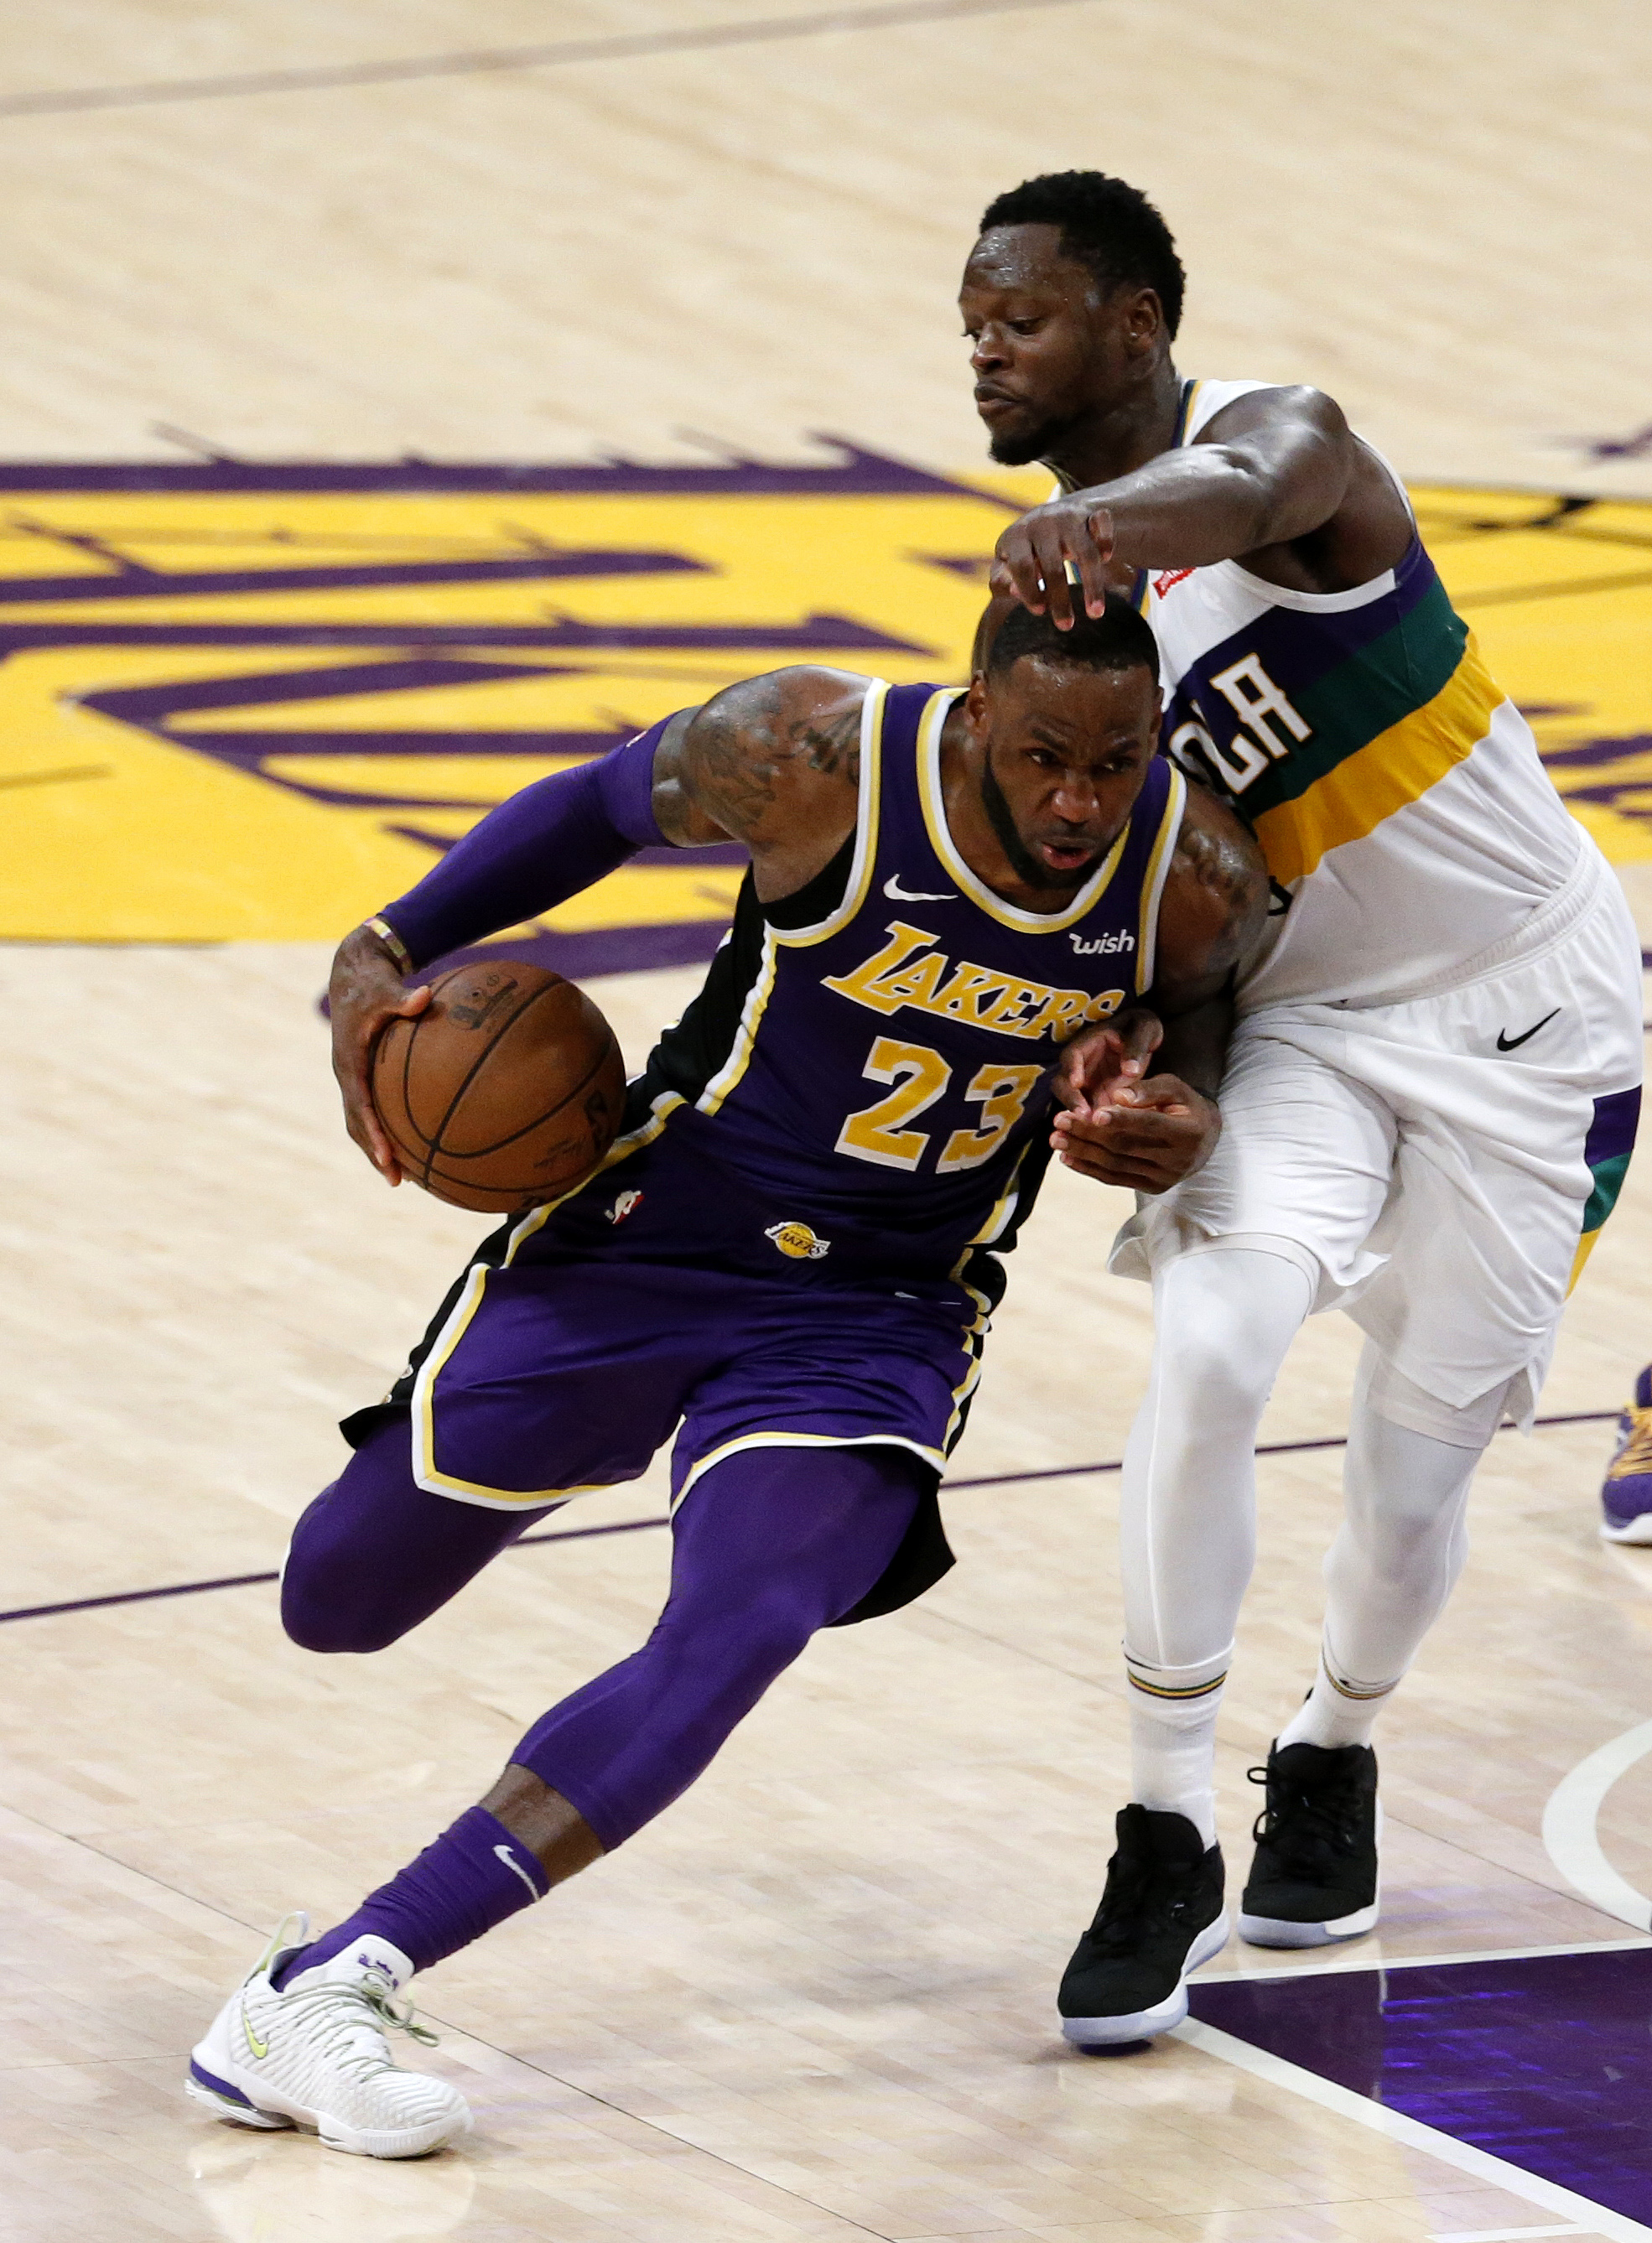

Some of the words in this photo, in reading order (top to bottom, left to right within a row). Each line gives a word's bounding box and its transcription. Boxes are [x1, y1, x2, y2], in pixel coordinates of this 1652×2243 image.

[1170, 652, 1313, 807] OLA
[1068, 928, 1135, 954] wish
[834, 1036, 1046, 1174] 23
